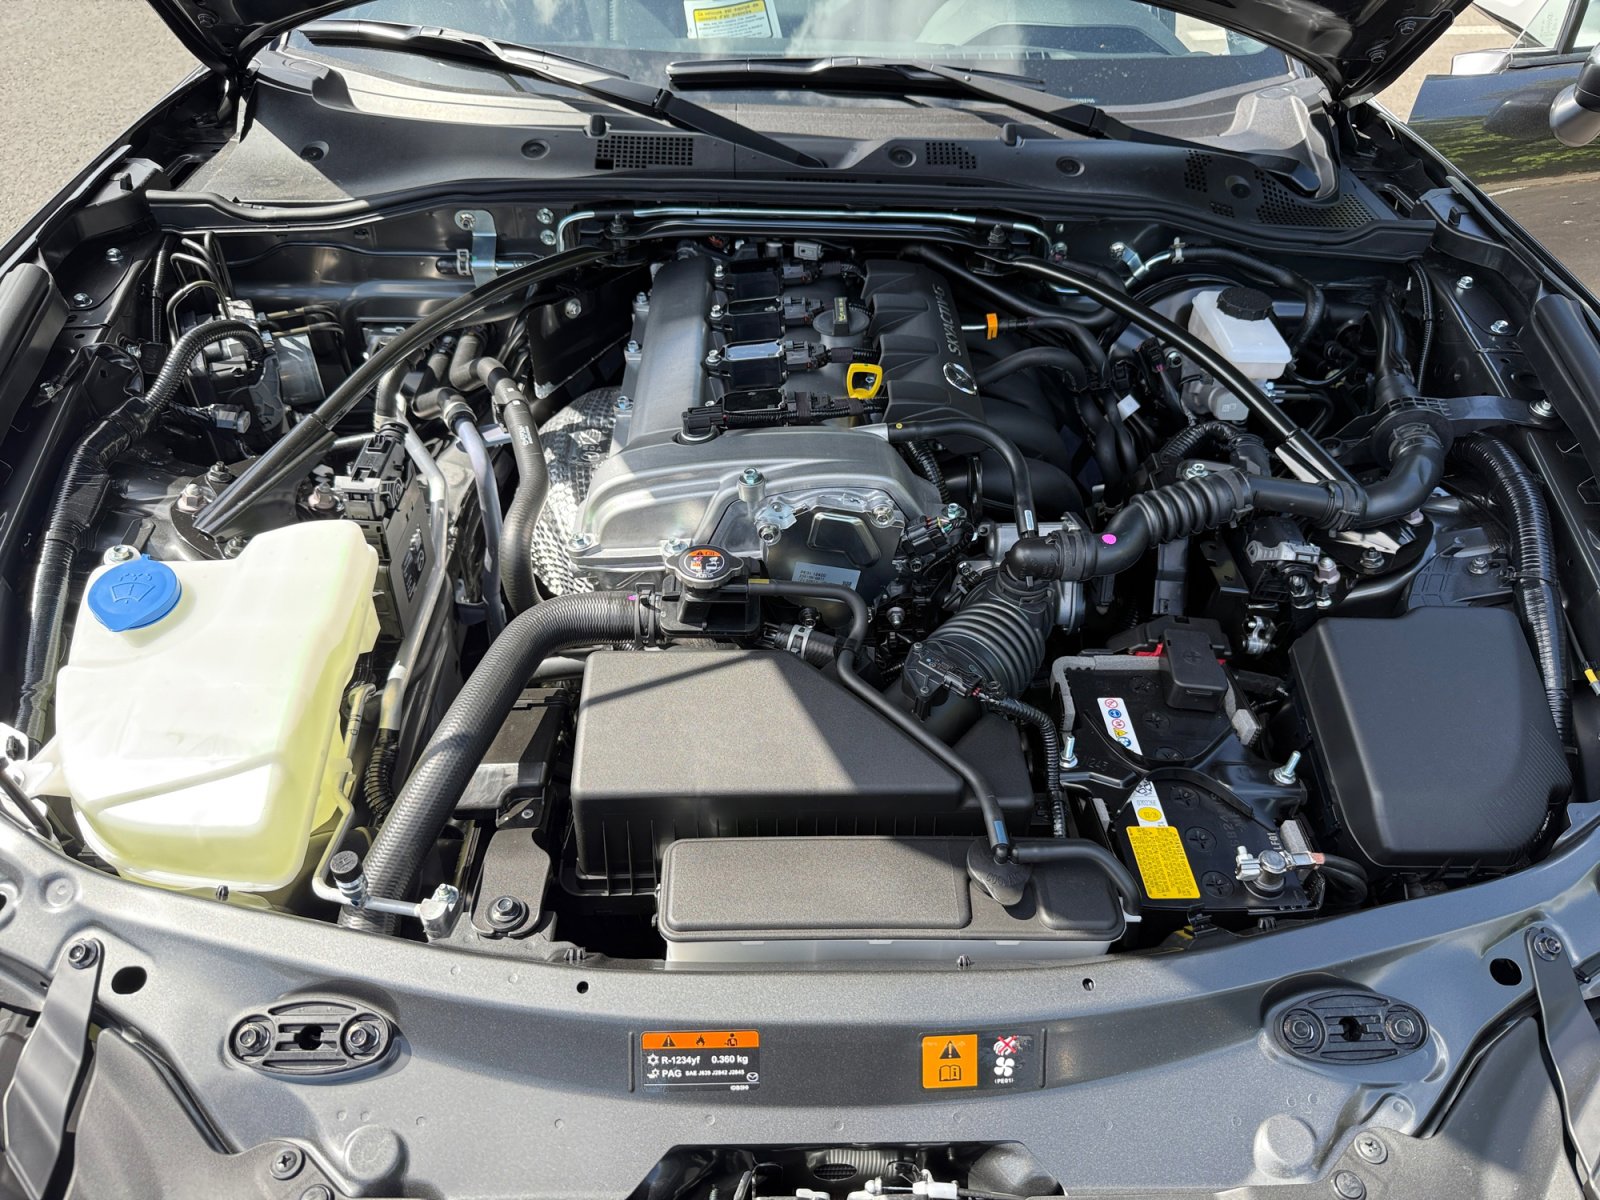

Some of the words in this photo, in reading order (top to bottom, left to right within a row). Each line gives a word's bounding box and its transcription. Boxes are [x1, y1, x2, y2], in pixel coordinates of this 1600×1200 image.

[932, 283, 961, 356] SKYACTIV-G
[1267, 832, 1283, 850] LF01
[661, 1055, 701, 1066] R-1234yf
[711, 1055, 735, 1064] 0.360
[737, 1055, 749, 1065] kg
[661, 1069, 682, 1078] PAG
